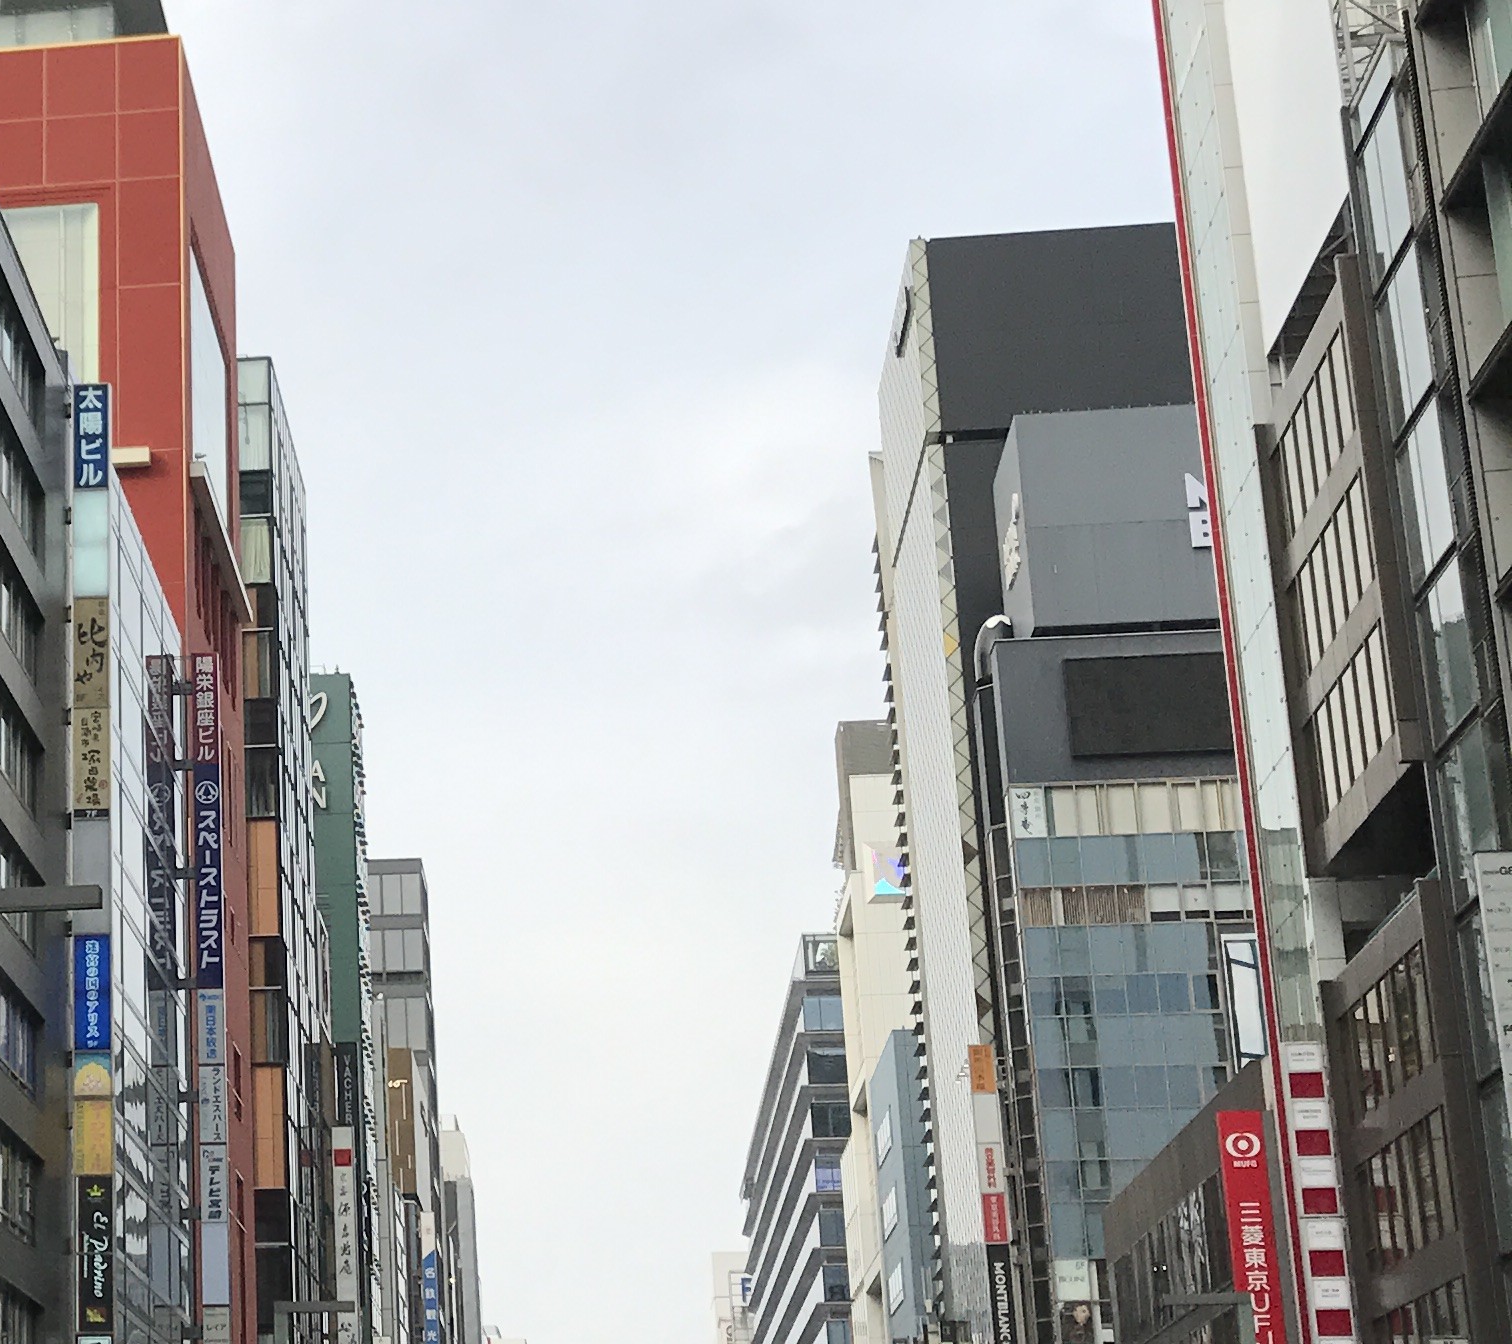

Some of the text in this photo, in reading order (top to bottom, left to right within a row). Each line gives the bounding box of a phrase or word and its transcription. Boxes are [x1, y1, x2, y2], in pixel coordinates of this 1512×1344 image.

[78, 387, 103, 488] 太陽ビル
[195, 656, 215, 762] 陽栄銀座ビル
[197, 809, 220, 970] スペーストラスト
[1233, 1159, 1258, 1168] MUFG
[994, 1262, 1012, 1342] MONTBLANC
